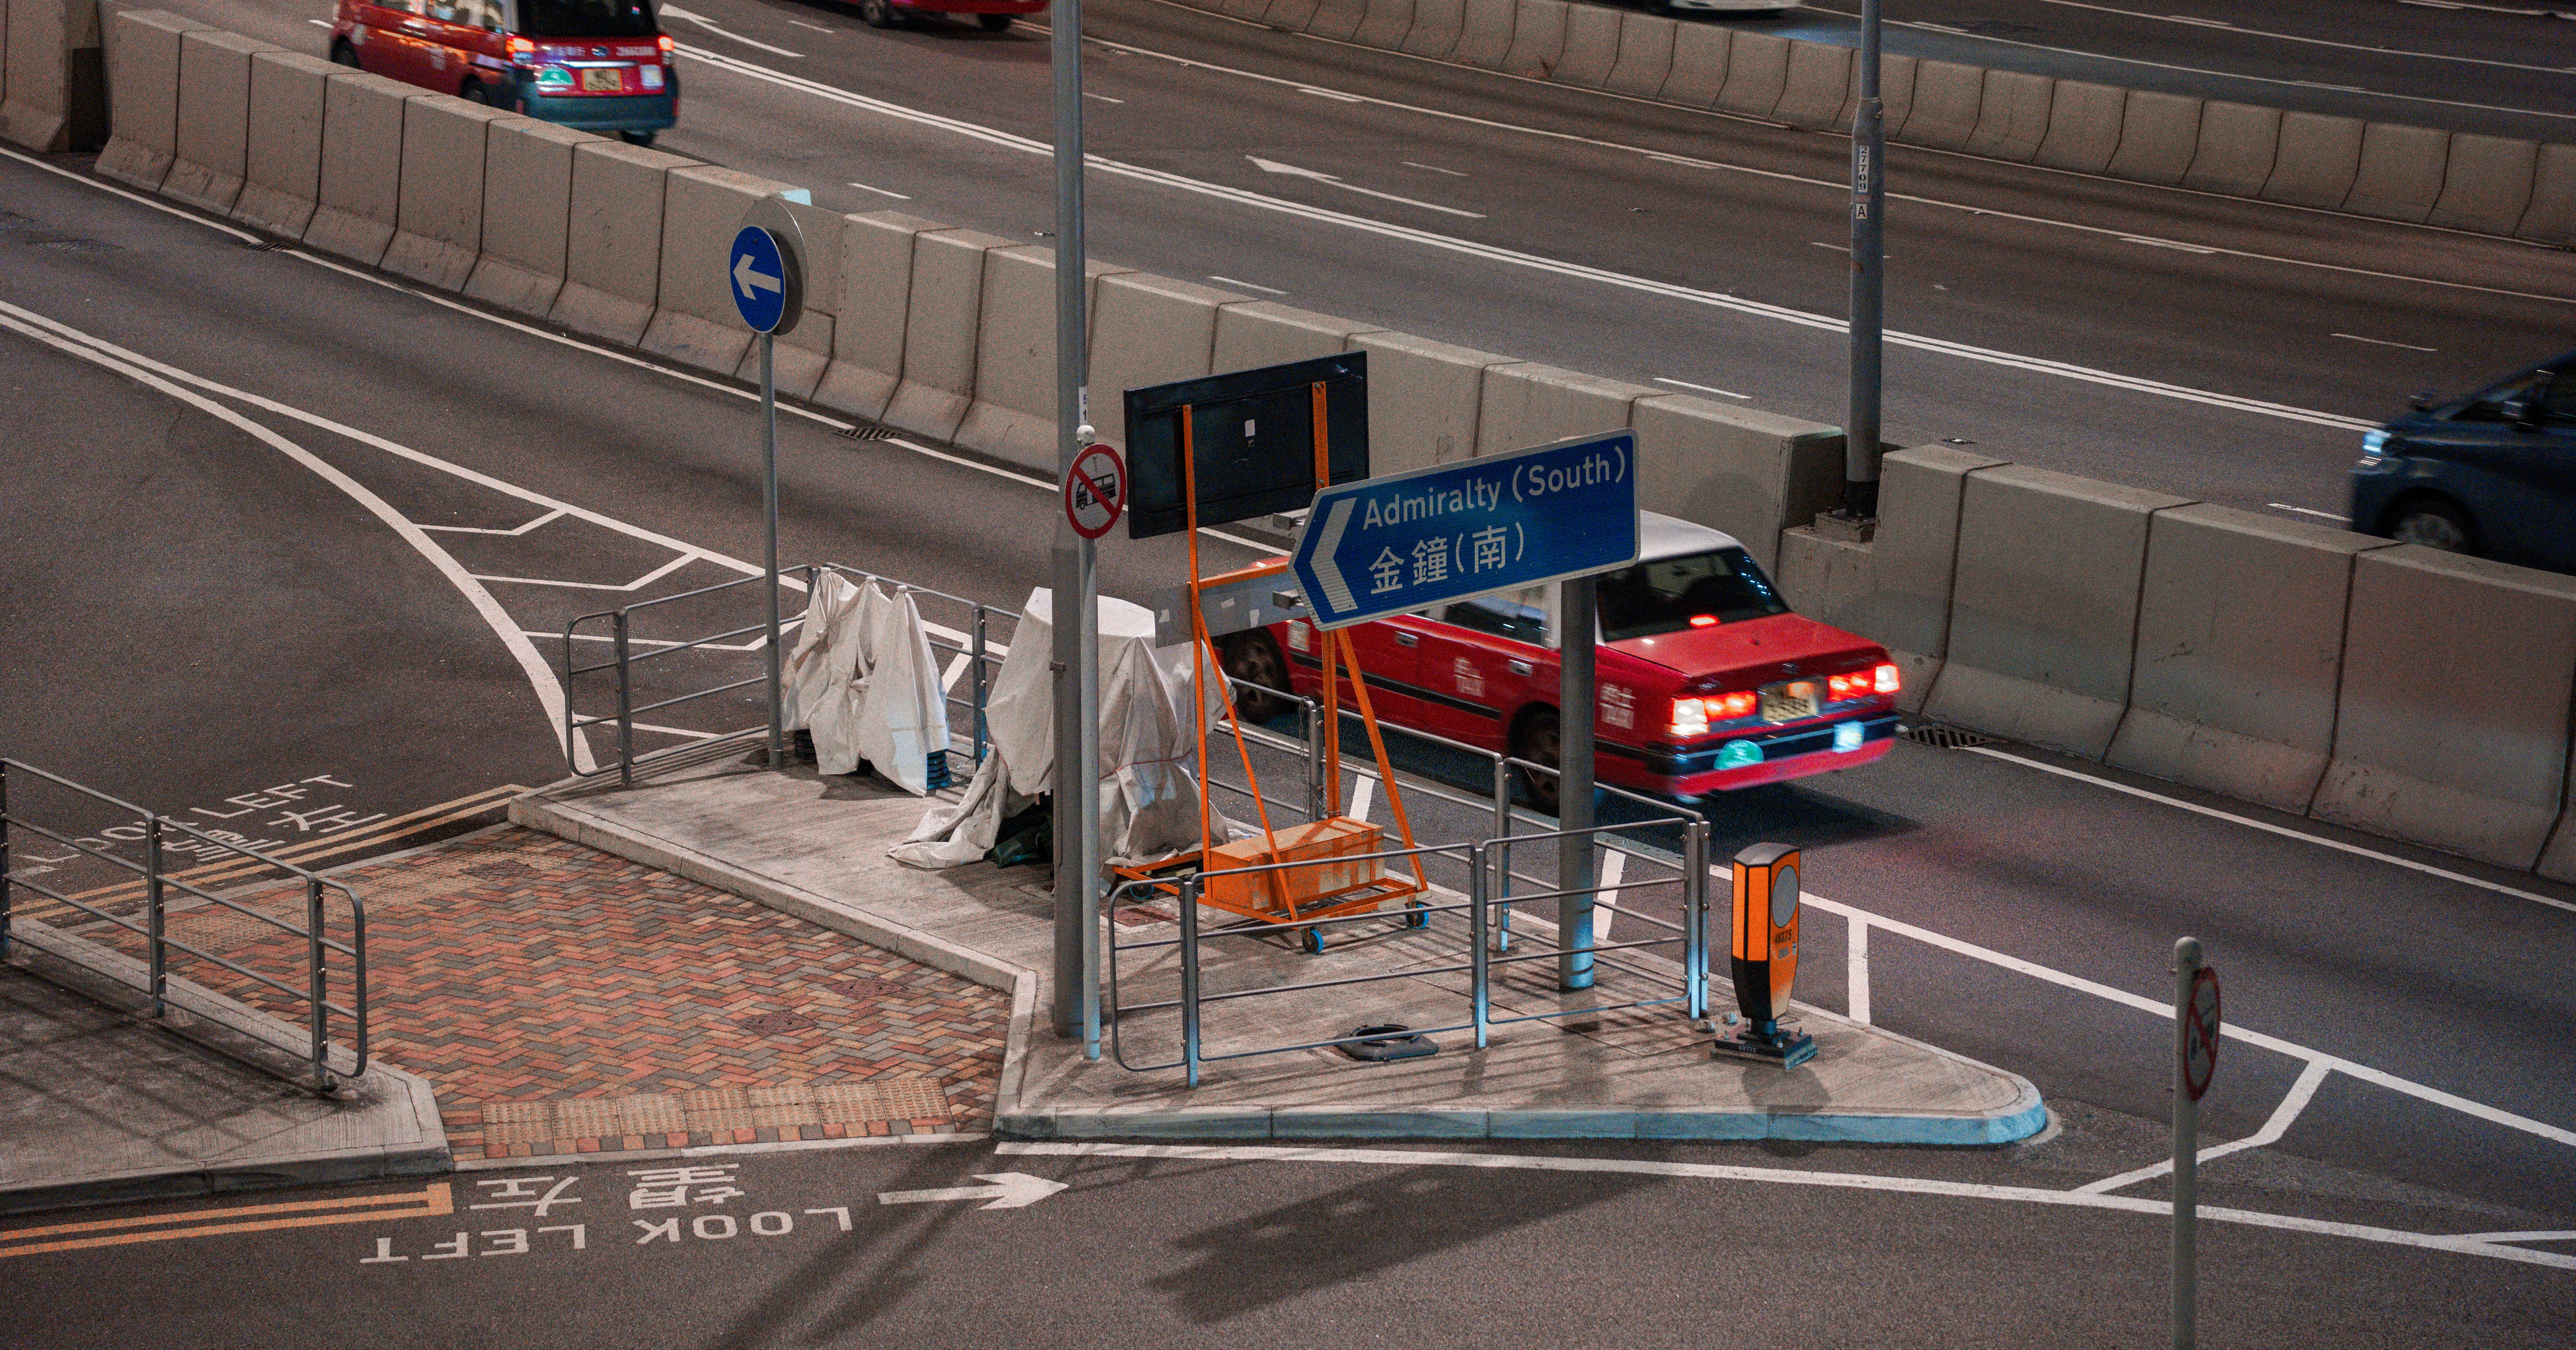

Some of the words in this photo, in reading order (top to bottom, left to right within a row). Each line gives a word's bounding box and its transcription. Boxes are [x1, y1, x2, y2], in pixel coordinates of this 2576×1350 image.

[1858, 146, 1867, 190] 27709
[1857, 205, 1866, 217] A
[1363, 477, 1501, 530] Admiralty
[1512, 445, 1625, 503] (South)
[1368, 521, 1524, 594] 金鐘(南)
[189, 775, 353, 818] LEFT
[469, 1163, 745, 1216] 望左
[360, 1224, 586, 1263] LEFT
[632, 1207, 853, 1245] LOOK
